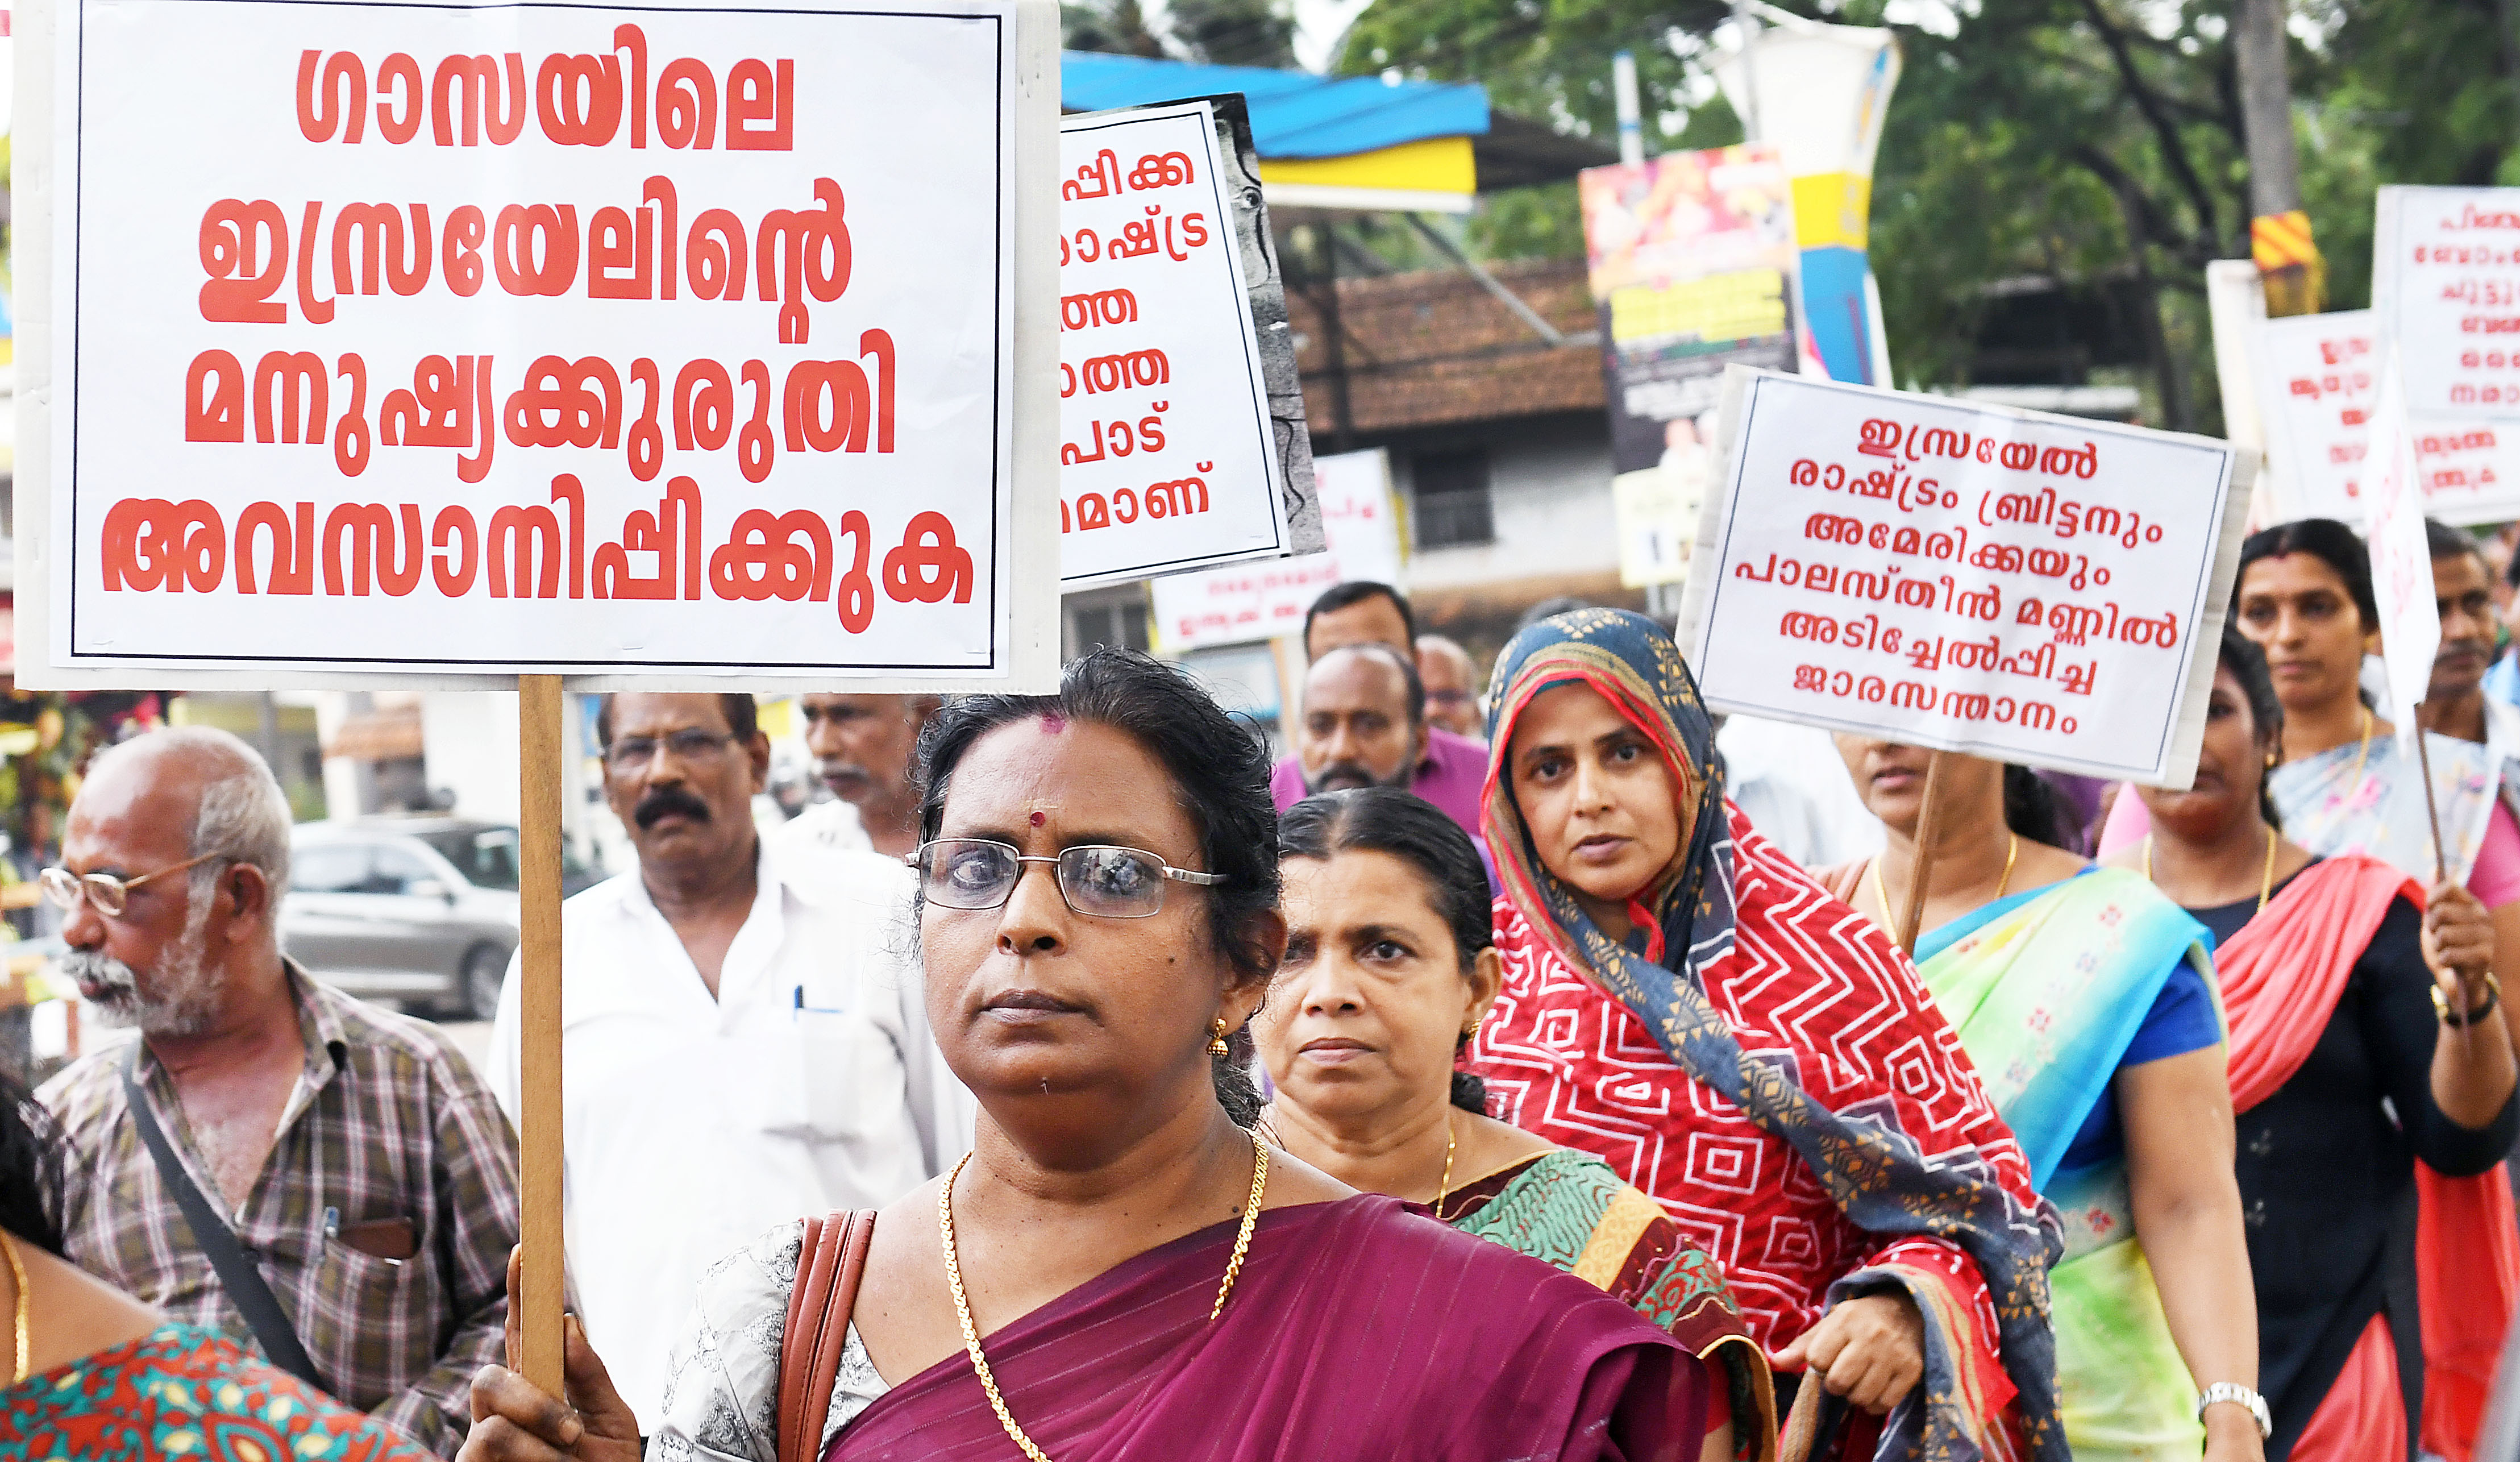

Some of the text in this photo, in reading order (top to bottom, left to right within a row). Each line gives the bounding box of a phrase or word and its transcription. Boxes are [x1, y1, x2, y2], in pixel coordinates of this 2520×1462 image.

[296, 23, 794, 151] ഗാസയിലെ
[1062, 148, 1194, 201] പ്പിക്ക
[198, 175, 852, 344] ഇസ്രയേലിന്റെ
[1061, 204, 1208, 267] ാഷ്ട്ര
[1061, 288, 1138, 333] ത്ത
[185, 328, 896, 484] മനുഷ്യക്കുരുതി
[1061, 400, 1169, 466] പാട്
[1857, 418, 2098, 480] ഇസ്രയേൽ
[1061, 460, 1213, 534] മാണ്
[1790, 458, 2163, 549] രാഷ്ട്രം ബ്രിട്ടനും
[101, 473, 974, 634] അവസാനിപ്പിക്കുക
[1804, 512, 2111, 592] അമേരിക്കയും
[1735, 553, 2178, 649] പാലസ്തീൻ മണ്ണിൽ
[1794, 664, 2078, 734] ജാരസന്താനം
